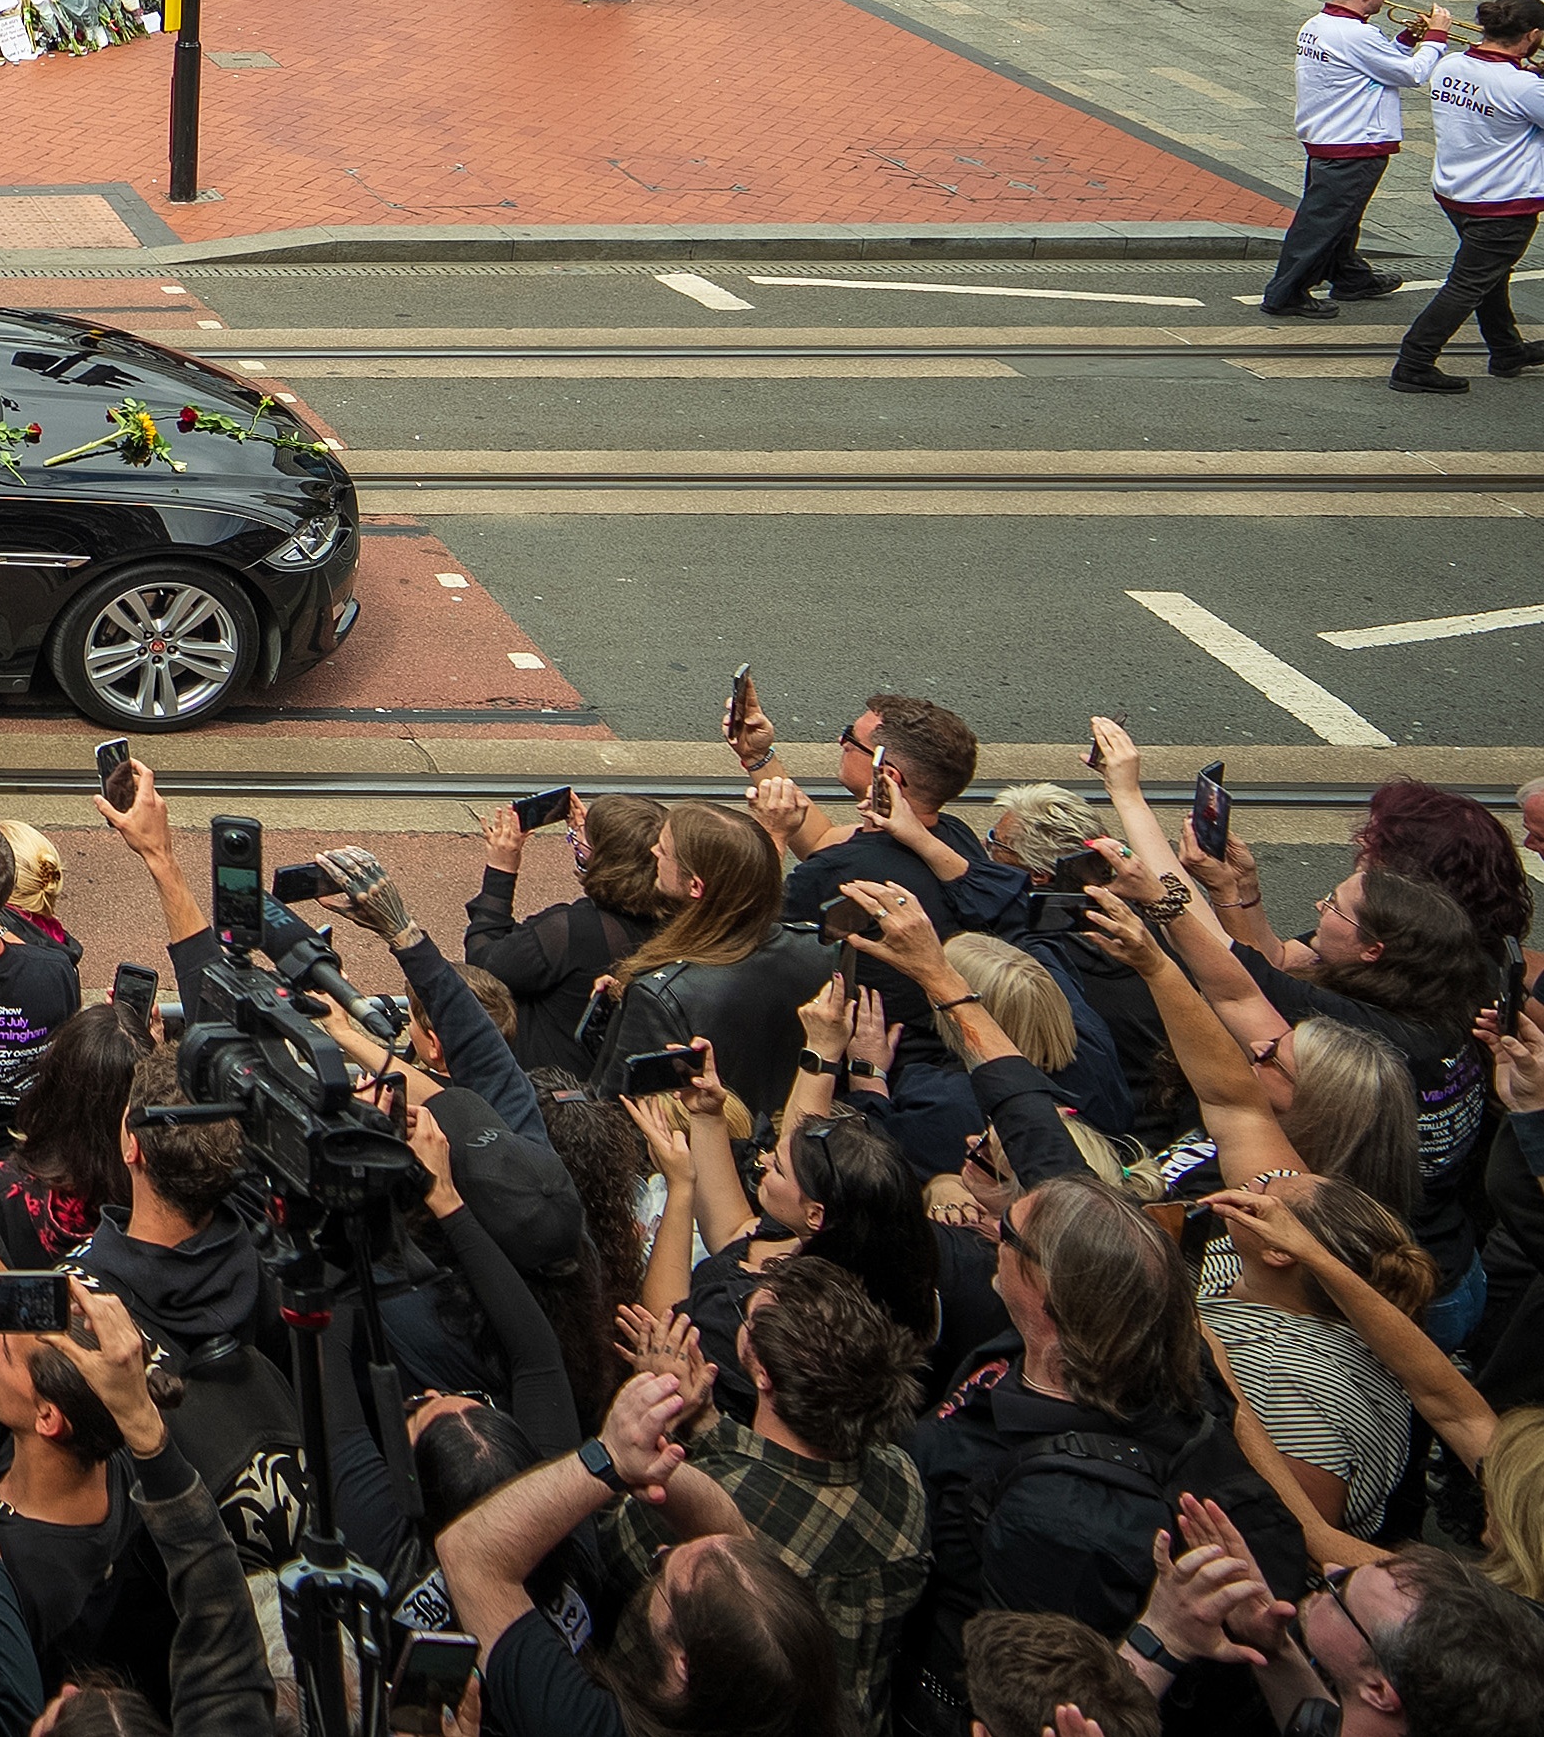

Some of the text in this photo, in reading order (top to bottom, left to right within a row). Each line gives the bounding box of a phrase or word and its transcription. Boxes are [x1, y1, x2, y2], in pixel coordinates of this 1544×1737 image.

[1296, 45, 1330, 63] OURNE
[1442, 76, 1479, 96] OZZY
[1431, 89, 1495, 118] SBOURNE
[3, 1016, 29, 1030] July
